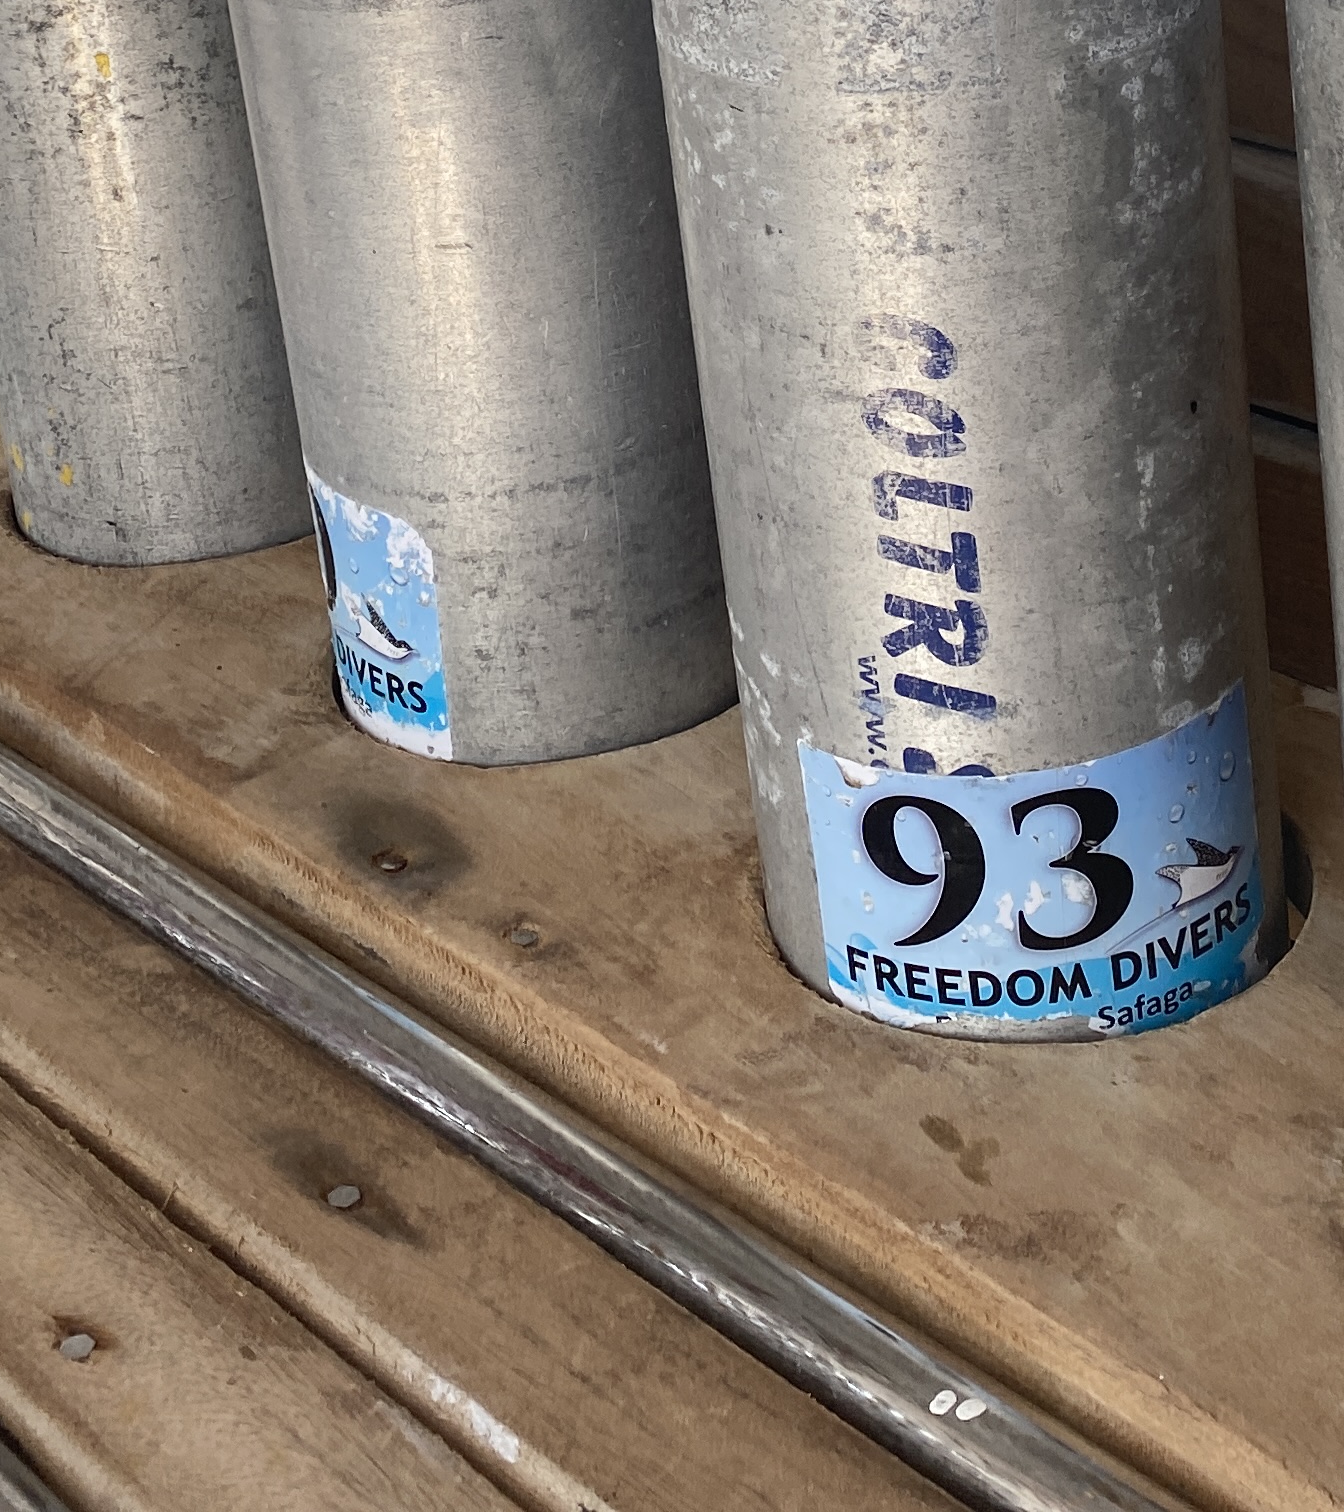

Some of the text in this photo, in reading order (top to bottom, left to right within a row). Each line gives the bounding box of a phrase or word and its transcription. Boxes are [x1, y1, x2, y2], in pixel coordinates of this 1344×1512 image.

[859, 313, 997, 719] COLTRI
[335, 634, 427, 714] DIVERS
[861, 788, 1135, 951] 93
[845, 883, 1253, 1008] FREEDOM DIVERS
[1098, 979, 1194, 1031] Safaga
